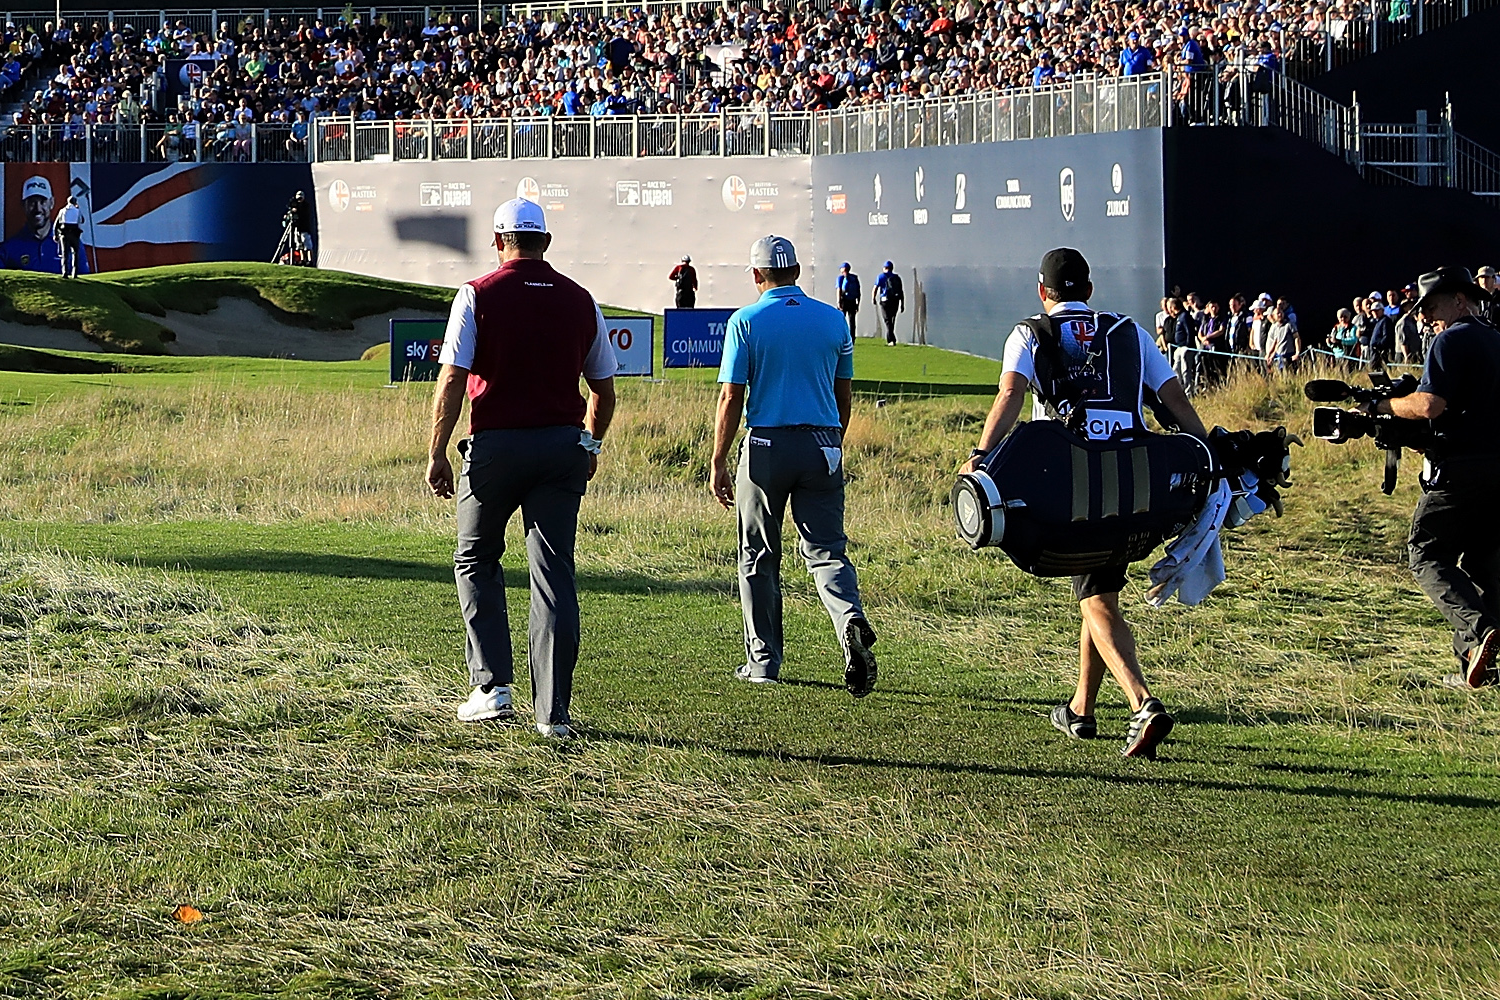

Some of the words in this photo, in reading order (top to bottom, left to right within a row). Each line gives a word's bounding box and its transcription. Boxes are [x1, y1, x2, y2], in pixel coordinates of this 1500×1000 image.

[26, 182, 46, 190] PING
[541, 189, 569, 197] MASTERS
[748, 188, 778, 196] MASTERS
[351, 190, 376, 198] MASTERS
[444, 191, 471, 206] DUBAI
[642, 190, 672, 206] DUBAI
[1106, 200, 1129, 216] ZURICH
[708, 323, 726, 335] TA
[609, 328, 632, 350] ro
[406, 341, 428, 360] sky
[672, 340, 723, 354] COMMUN
